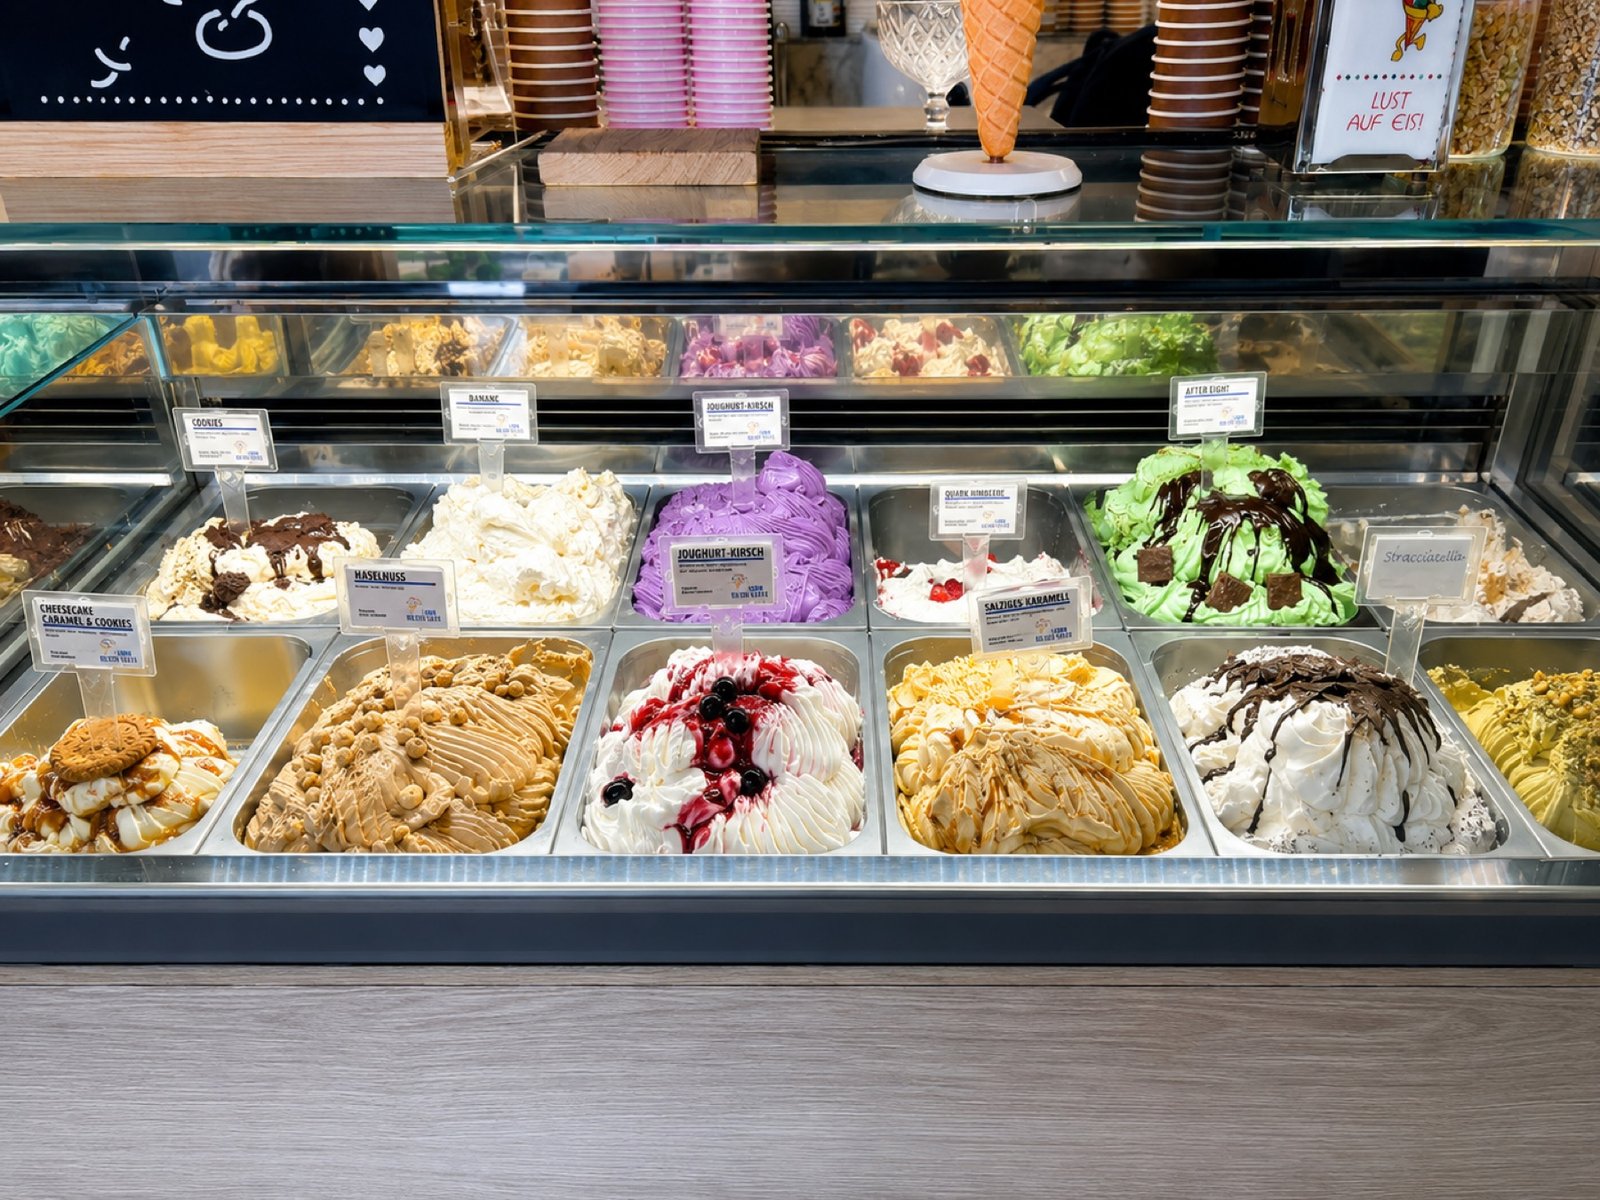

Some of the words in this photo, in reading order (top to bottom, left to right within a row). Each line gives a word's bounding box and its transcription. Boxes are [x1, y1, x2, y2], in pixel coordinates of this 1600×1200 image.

[1371, 91, 1412, 110] LUST
[1346, 113, 1383, 131] AUF
[1391, 113, 1424, 131] EIS!
[1185, 386, 1208, 395] AFTER
[1209, 385, 1230, 394] EIGHT
[192, 418, 223, 427] COOKIES
[678, 547, 764, 560] JOUGHURT-KIRSCH
[1383, 546, 1465, 564] Stracciatella
[354, 570, 406, 581] HASELNUSS
[984, 599, 1024, 612] SALZIGES
[1025, 592, 1070, 606] KARAMELL
[40, 604, 94, 616] CHEESECAKE
[42, 614, 85, 626] CARAMEL
[95, 617, 133, 628] COOKIES
